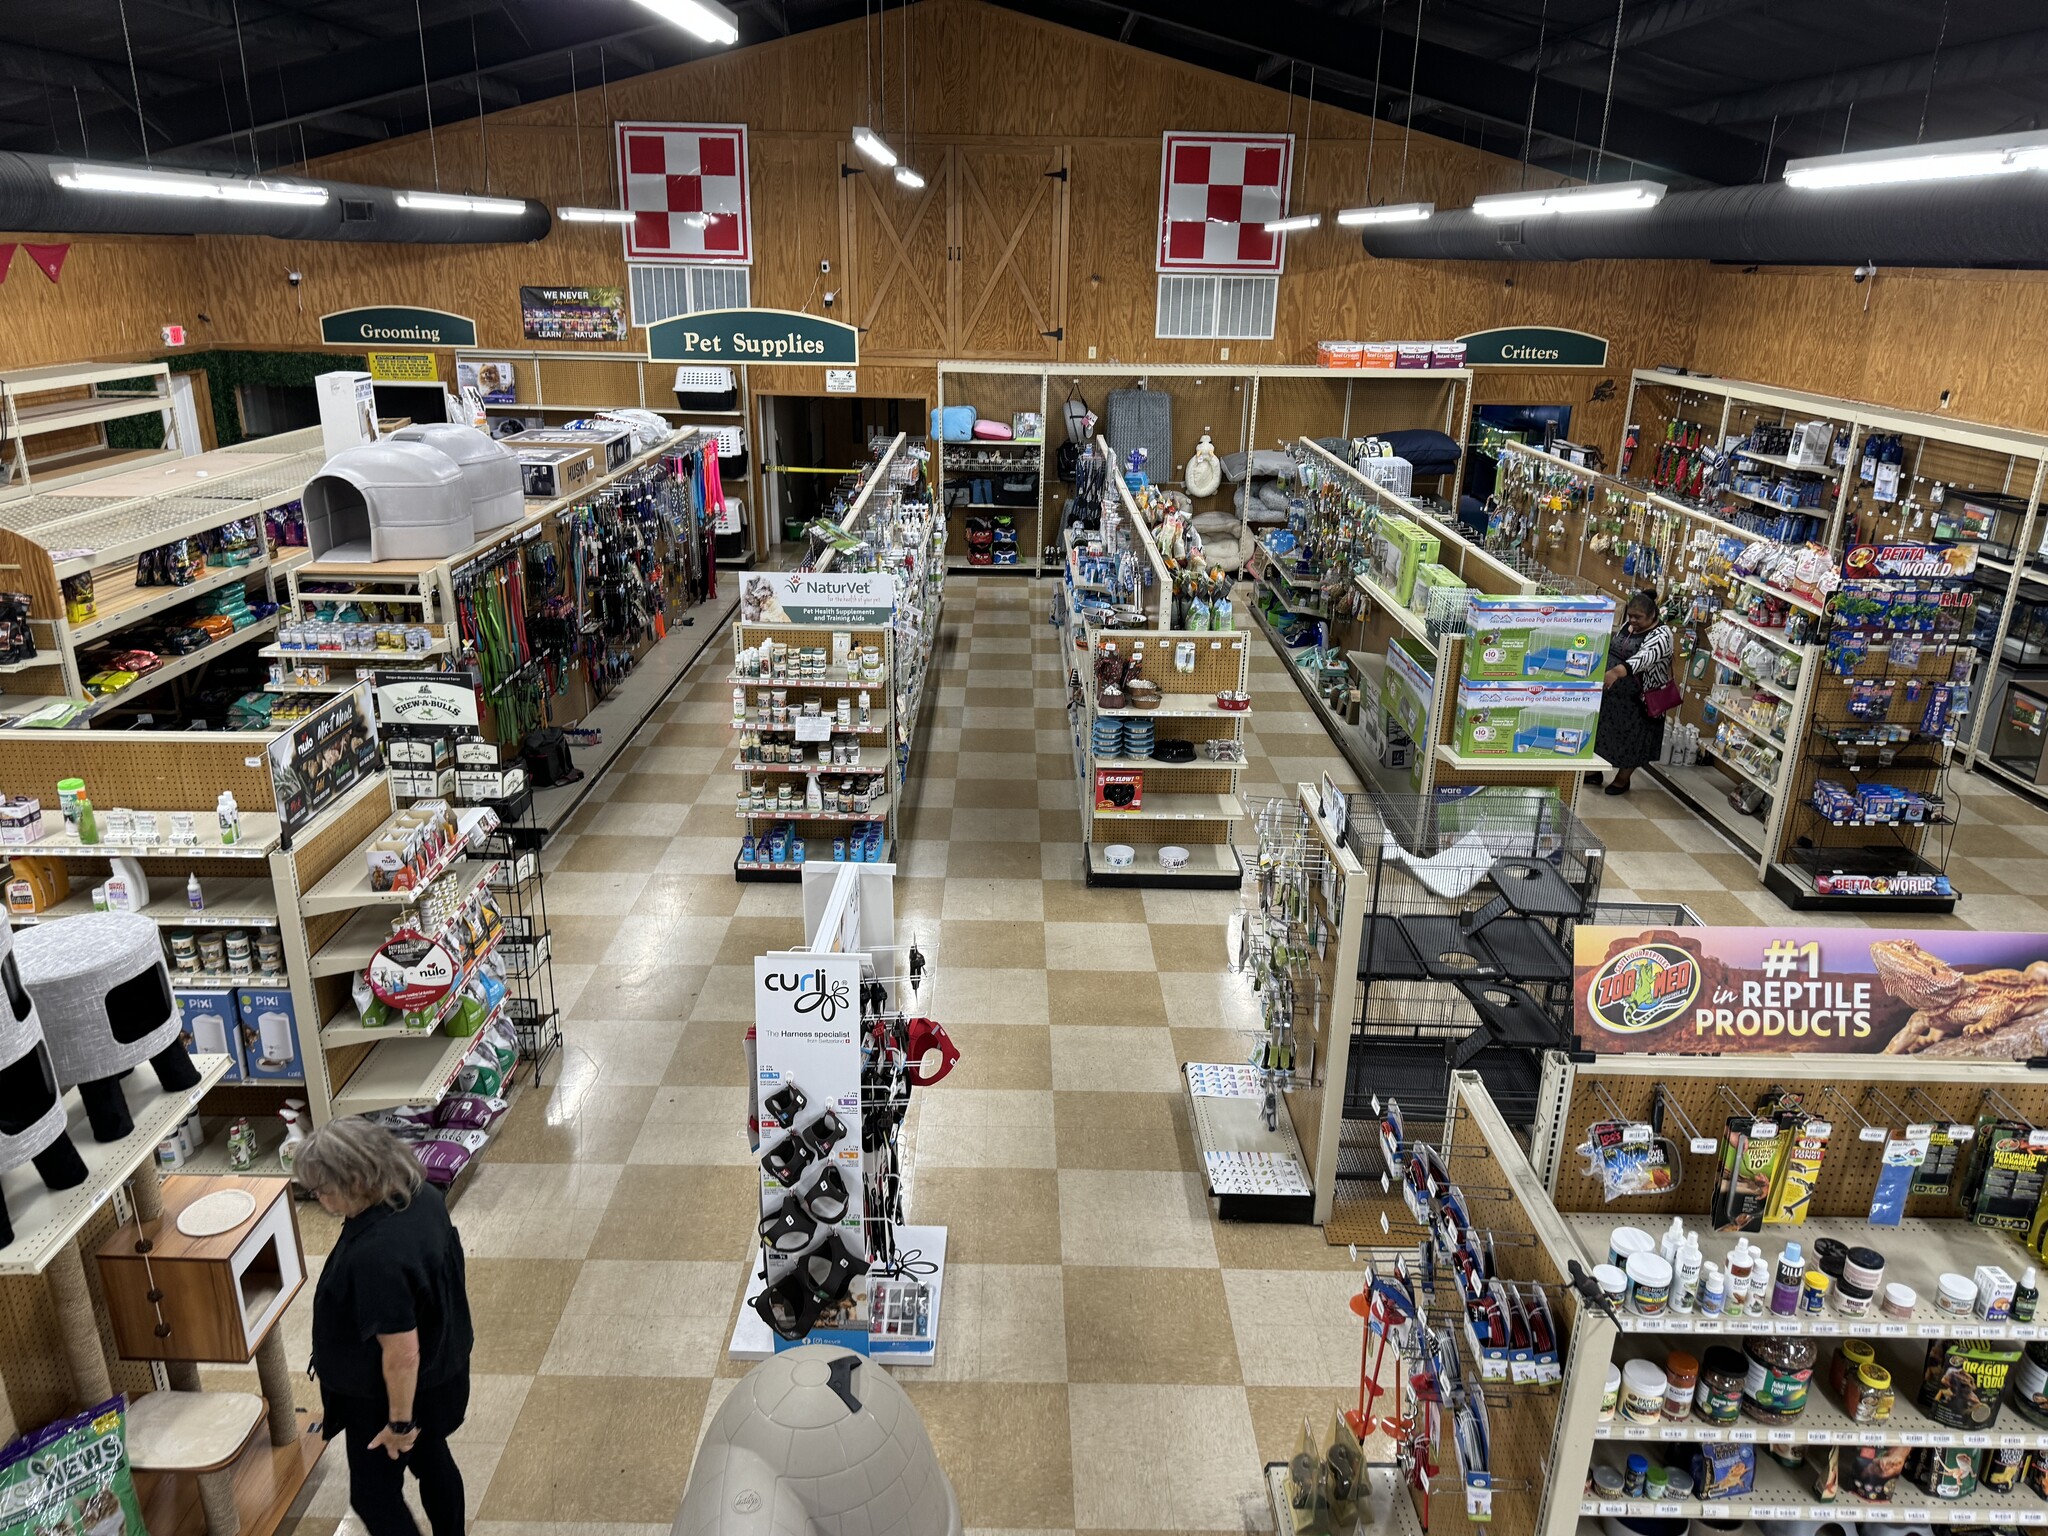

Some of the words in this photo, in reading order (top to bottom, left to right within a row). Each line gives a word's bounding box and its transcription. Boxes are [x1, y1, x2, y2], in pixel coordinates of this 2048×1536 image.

[543, 291, 557, 299] WE
[560, 291, 589, 299] NEVER
[360, 324, 440, 343] Grooming
[683, 332, 722, 352] Pet
[732, 332, 825, 357] Supplies
[1501, 344, 1559, 360] Critters
[1880, 547, 1925, 560] BETTA
[1900, 562, 1952, 577] WORLD
[807, 581, 870, 594] NaturVet
[1940, 592, 1973, 607] RLD
[835, 608, 875, 616] Supplements
[298, 736, 314, 755] nulo
[1835, 880, 1870, 890] BETTA
[1889, 880, 1932, 891] WORLD
[1614, 956, 1628, 973] SAVE
[1627, 950, 1644, 960] YOUR
[1644, 950, 1671, 969] REPTILES
[1762, 939, 1820, 978] #1
[420, 966, 446, 978] nulo
[1599, 968, 1637, 1006] ZOO
[1653, 961, 1691, 998] MED
[1713, 985, 1738, 1004] in
[1743, 981, 1871, 1009] REPTILE
[1696, 1009, 1871, 1037] PRODUCTS
[814, 1030, 850, 1038] specialist
[1994, 1151, 2047, 1162] NATURALISTIC
[1963, 1360, 2009, 1376] DRAGON
[1976, 1375, 2004, 1389] FOOD
